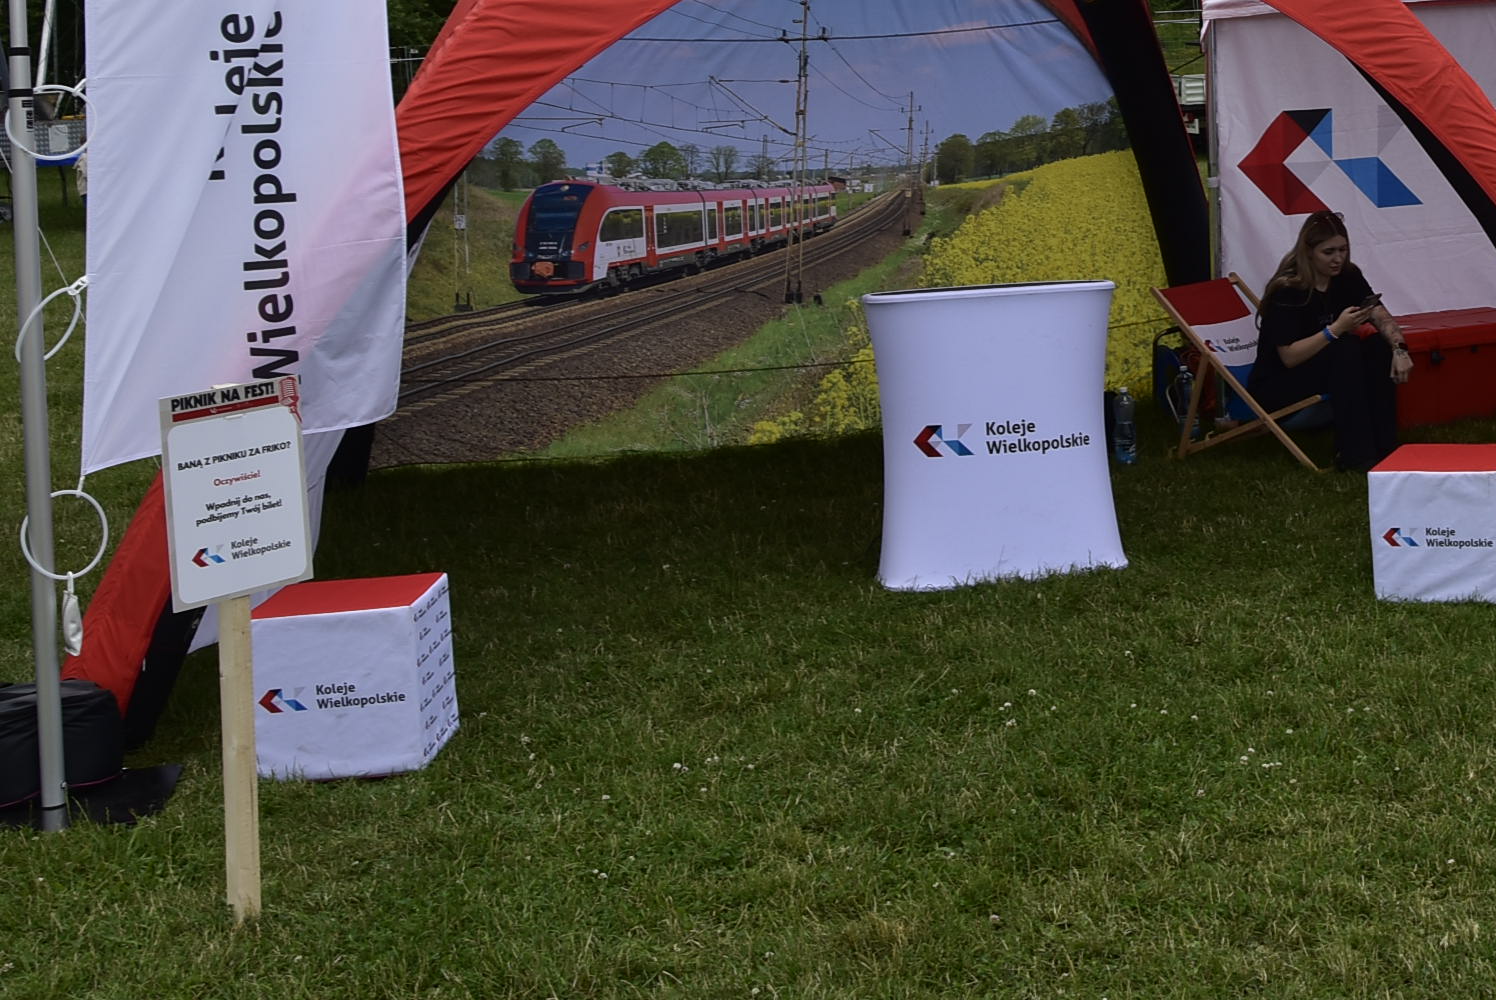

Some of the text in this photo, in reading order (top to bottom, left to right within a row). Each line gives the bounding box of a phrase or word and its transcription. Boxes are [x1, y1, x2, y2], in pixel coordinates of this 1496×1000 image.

[171, 391, 217, 413] PIKNIK
[220, 386, 241, 402] NA
[244, 382, 275, 398] FEST!
[986, 419, 1036, 436] Koleje
[986, 432, 1090, 454] Wielkopolskie
[177, 441, 292, 471] BANĄ Z PIKNIKU ZA FRIKO?
[213, 470, 261, 486] Oczywiście!
[205, 497, 241, 511] Wpadnij
[242, 494, 253, 504] do
[195, 510, 240, 527] podbijemy
[241, 504, 261, 516] Twój
[1425, 527, 1456, 537] Koleje
[230, 536, 258, 549] Koleje
[231, 541, 291, 560] Wielkopolskie
[1426, 538, 1493, 549] Wielkopolskie
[315, 682, 356, 696] Koleje
[317, 691, 406, 709] Wielkopolskie
